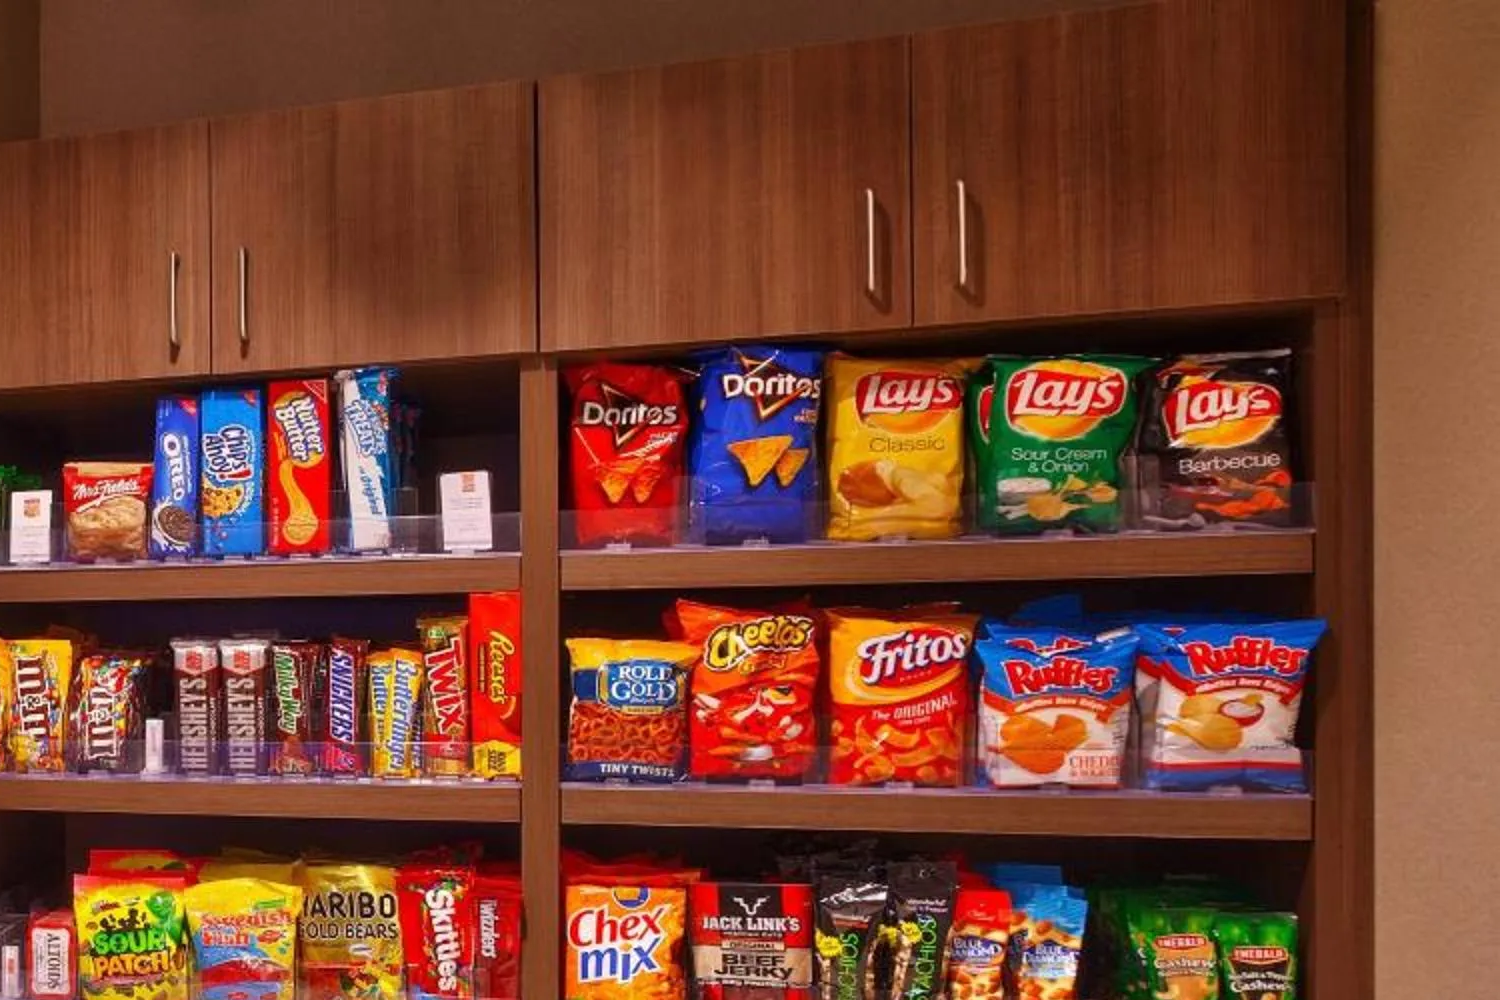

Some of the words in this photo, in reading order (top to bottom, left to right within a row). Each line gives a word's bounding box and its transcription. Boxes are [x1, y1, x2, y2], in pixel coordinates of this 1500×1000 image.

[723, 372, 821, 400] Doritos
[861, 374, 956, 414] Lay's
[1012, 371, 1120, 417] Lay's
[292, 395, 324, 458] Nutter
[583, 401, 677, 427] Doritos
[1175, 384, 1273, 434] Lay's
[275, 402, 309, 463] Butter
[867, 435, 946, 454] Classic
[162, 433, 187, 500] OREO
[1011, 446, 1050, 462] Sour
[1055, 446, 1108, 462] Cream
[1027, 460, 1039, 474] &
[1041, 459, 1089, 474] Onion
[1178, 454, 1282, 476] Barbecue
[707, 617, 812, 669] Cheetos
[858, 631, 968, 685] Fritos
[1182, 635, 1307, 678] Ruffles
[426, 636, 466, 734] TWIX
[611, 681, 676, 702] GOLD
[618, 664, 672, 681] ROLD
[1004, 656, 1118, 697] Ruffles
[329, 653, 356, 745] SNICKERS
[892, 692, 957, 720] ORIGINAL
[180, 677, 209, 770] HERSHEY'S
[227, 677, 257, 770] HERSHEY'S
[600, 763, 629, 777] TINY
[632, 764, 675, 778] TWISTS
[93, 930, 163, 955] SOUR
[426, 888, 461, 991] Skittles
[567, 904, 666, 947] Chex
[702, 916, 742, 931] JACK
[746, 915, 801, 932] LINK'S
[46, 932, 62, 988] ALTOIDS
[93, 953, 170, 978] PATCH
[580, 937, 660, 982] mix
[713, 966, 794, 981] JERKY
[721, 953, 785, 967] BEEF
[1234, 949, 1284, 959] EMERALD
